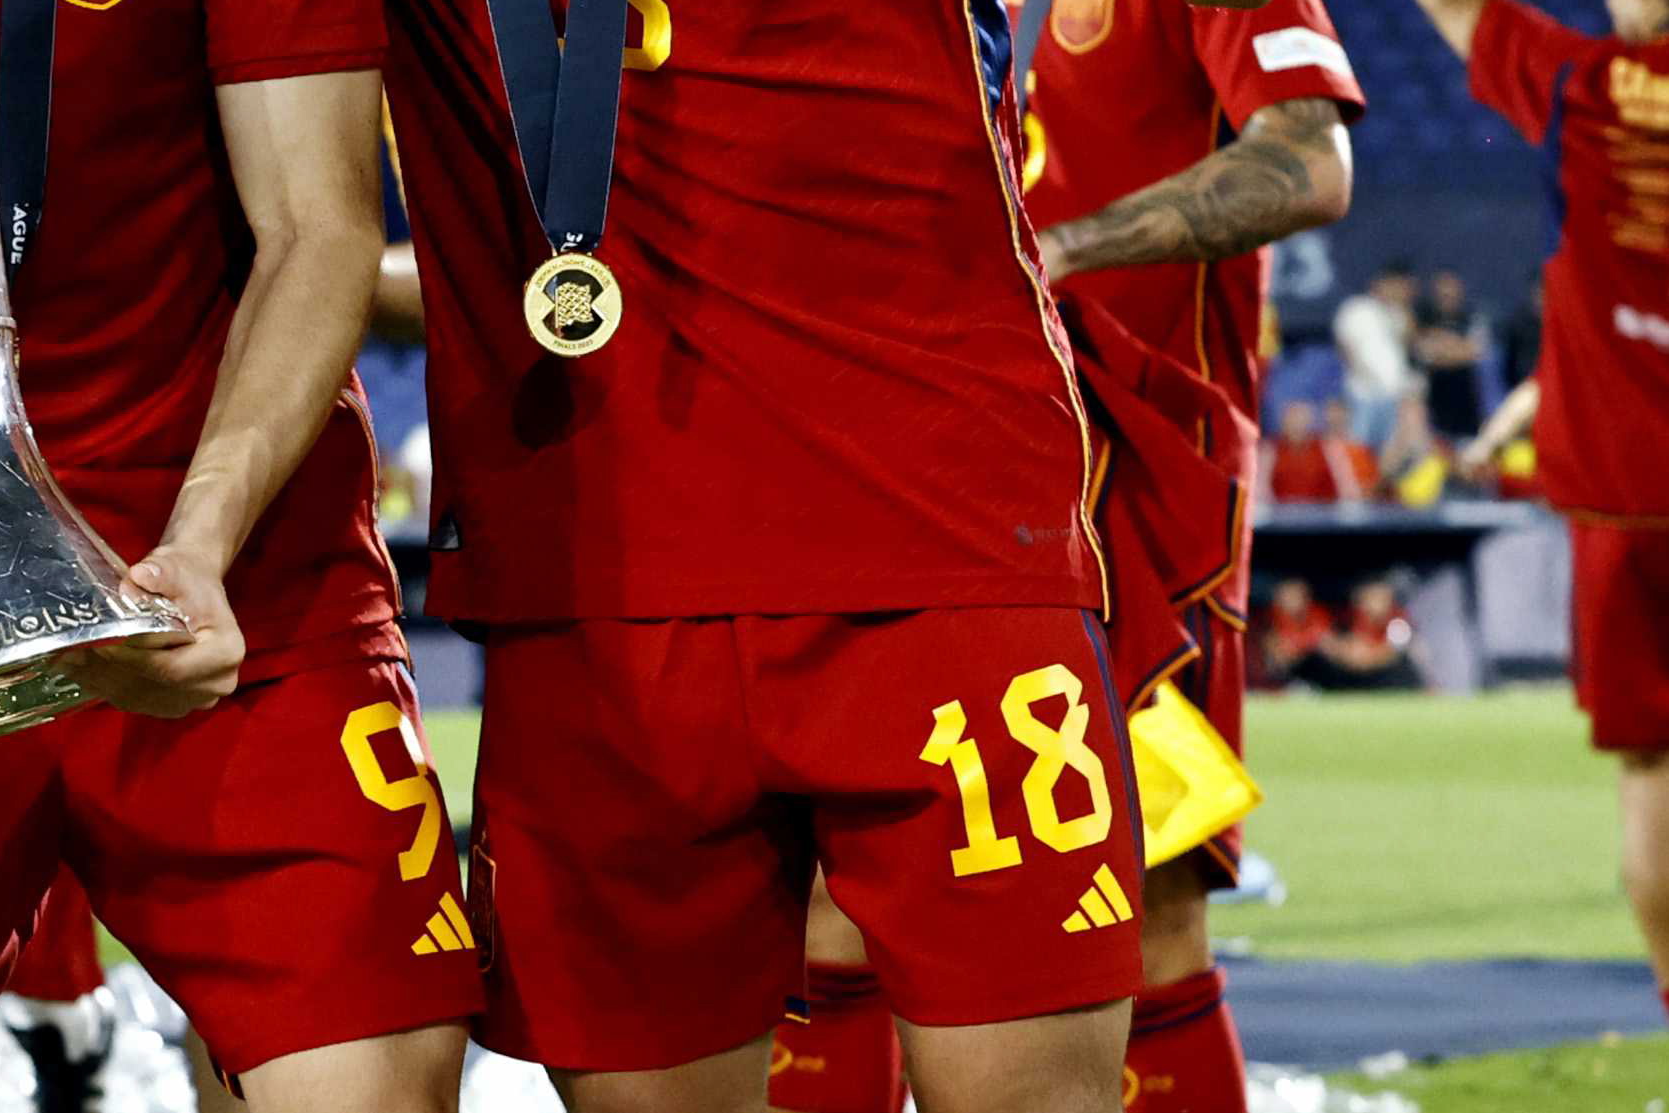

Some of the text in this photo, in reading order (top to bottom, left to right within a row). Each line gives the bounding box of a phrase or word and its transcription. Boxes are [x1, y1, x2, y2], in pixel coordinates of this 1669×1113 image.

[11, 205, 28, 265] AGUE
[340, 700, 441, 881] 9
[918, 663, 1113, 877] 18
